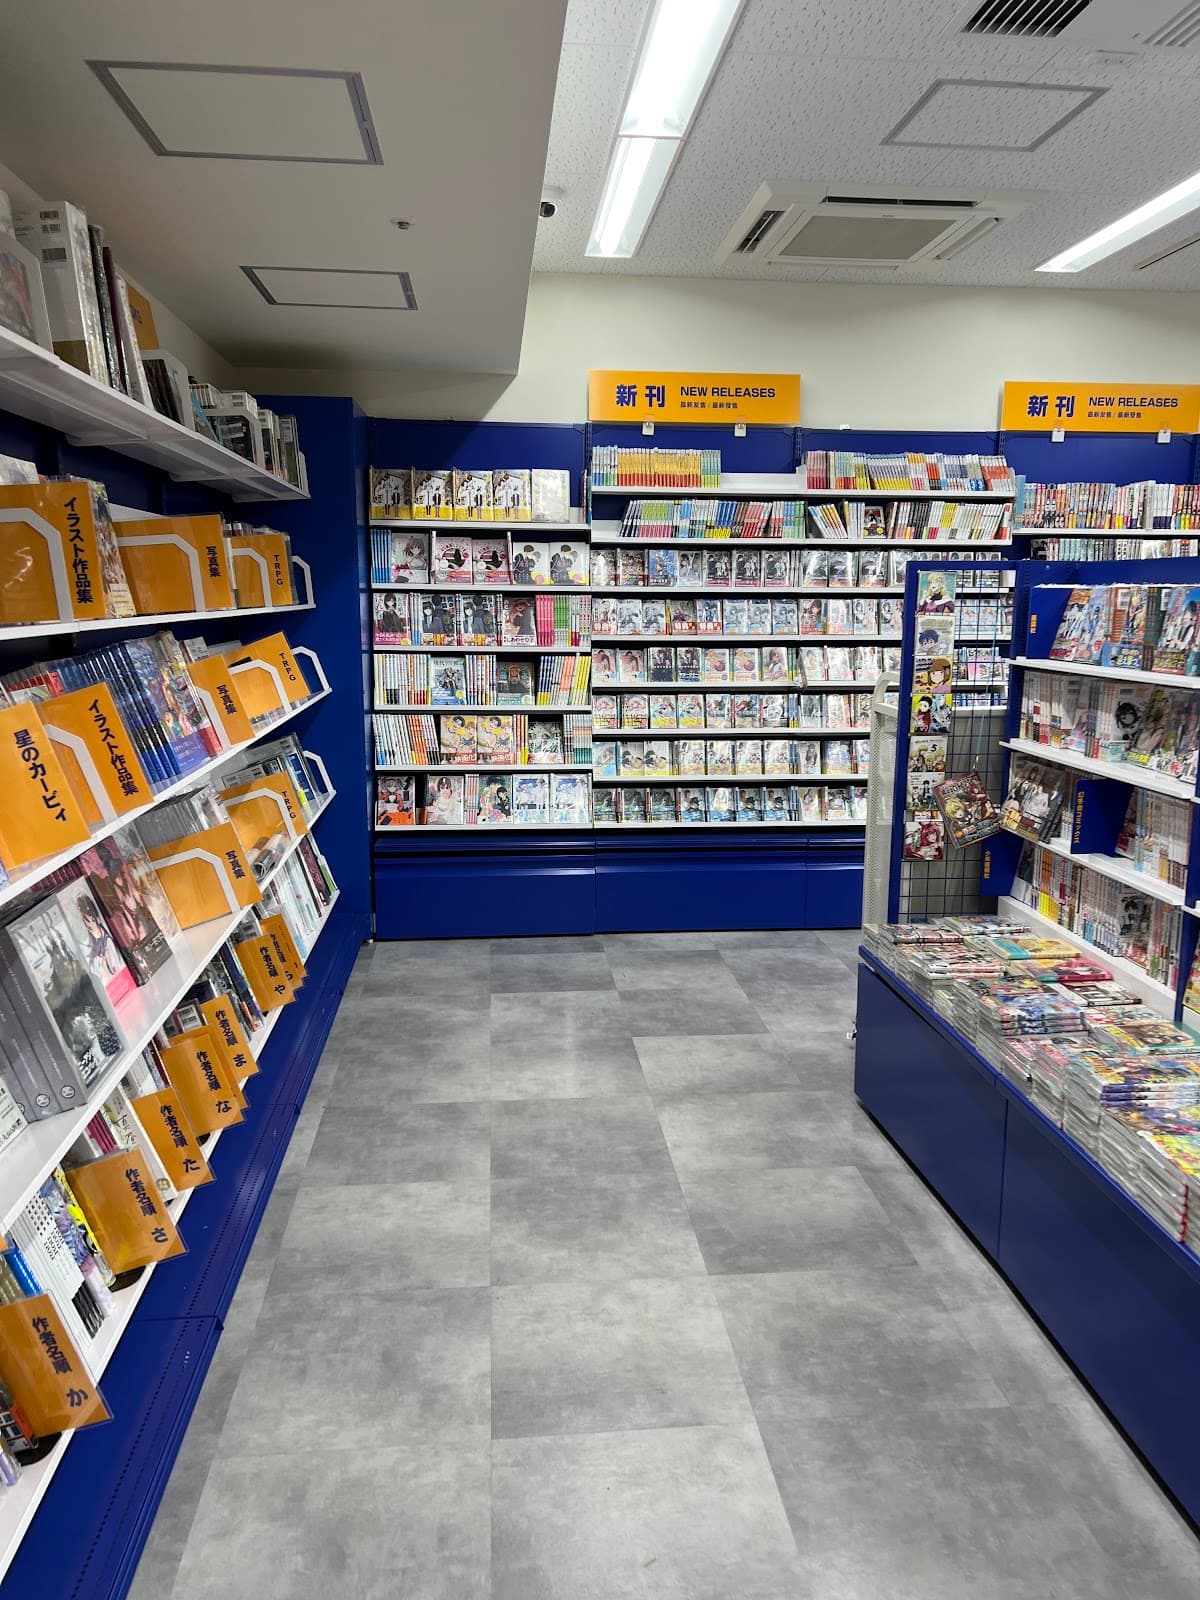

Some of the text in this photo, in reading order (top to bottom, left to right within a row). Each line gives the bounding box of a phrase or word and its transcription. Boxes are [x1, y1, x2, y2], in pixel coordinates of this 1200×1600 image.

[616, 384, 666, 408] 新刊
[680, 386, 776, 398] NEW RELEASES
[1027, 395, 1076, 418] 新刊
[1088, 397, 1179, 408] NEW RELEASES
[63, 496, 93, 604] イラスト作品集
[205, 545, 221, 578] 写真集
[272, 554, 284, 586] TRPG
[279, 652, 297, 682] TRPG
[216, 684, 237, 716] 写真集
[88, 698, 140, 797] イラスト作品集
[13, 728, 67, 821] 星のカービィ
[225, 849, 246, 880] 写真集
[259, 945, 286, 995] 作者名順 や
[215, 1009, 247, 1068] 作者名順 ま
[196, 1050, 232, 1114] 作者名順 な
[159, 1104, 201, 1173] 作者名順 た
[125, 1167, 158, 1217] 作者名順
[150, 1227, 169, 1244] さ
[31, 1316, 89, 1408] 作者名順 か
